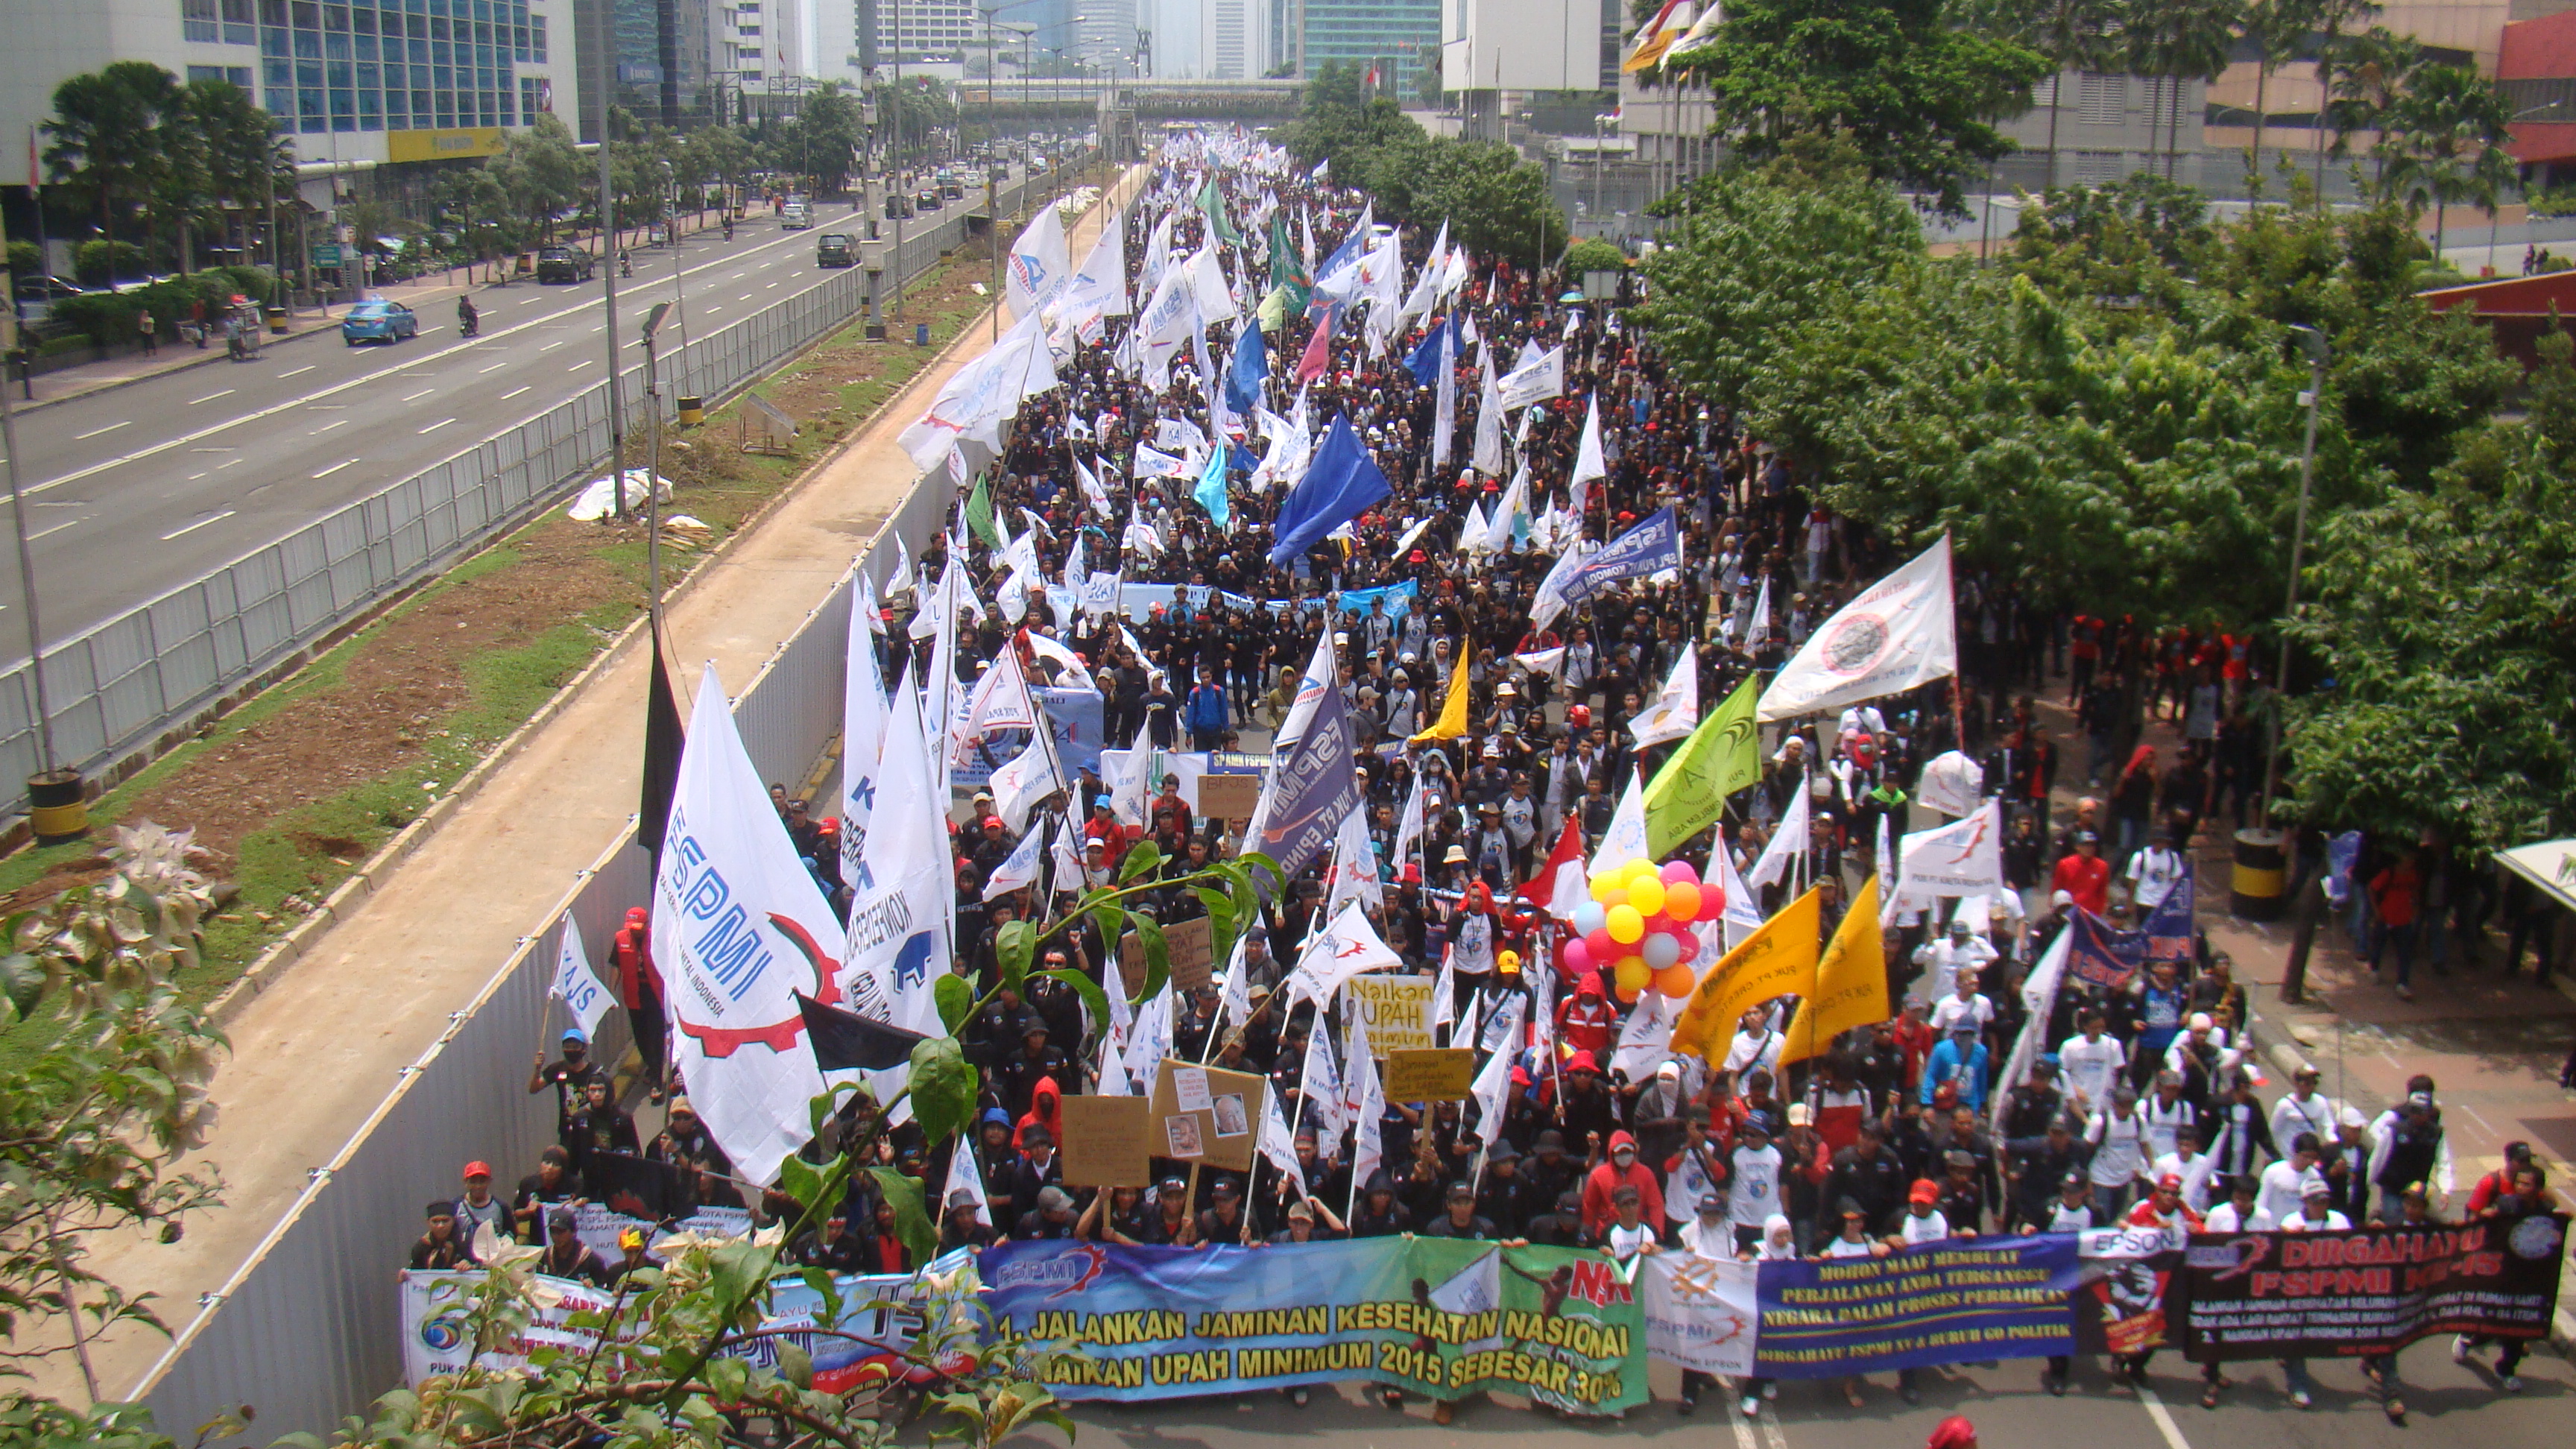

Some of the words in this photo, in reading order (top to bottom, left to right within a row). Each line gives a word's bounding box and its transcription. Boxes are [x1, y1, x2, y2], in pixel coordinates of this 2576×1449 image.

[1213, 754, 1225, 767] SP
[1225, 754, 1246, 767] AMK
[663, 805, 773, 1001] FSPMI
[691, 974, 725, 1019] INDONESIA
[1362, 1003, 1421, 1029] UPAH
[2094, 1232, 2176, 1252] EPSON
[2281, 1226, 2487, 1266] DIRGAHAYU
[997, 1259, 1076, 1286] FSPMI
[2250, 1268, 2393, 1298] FSPMI
[1781, 1280, 1895, 1304] PERJALANAN
[998, 1315, 1023, 1342] 1.
[1030, 1310, 1186, 1345] JALANKAN
[1194, 1304, 1328, 1339] JAMINAN
[1337, 1301, 1500, 1345] KESEHATAN
[1764, 1308, 1835, 1327] NEGARA
[1838, 1300, 1895, 1322] DALAM
[2007, 1323, 2071, 1339] POLITIK
[430, 1363, 455, 1374] PUK
[1152, 1350, 1229, 1385] UPAH
[1238, 1342, 1373, 1379] MINIMUM
[1380, 1340, 1444, 1386] 2015
[1448, 1350, 1570, 1396] SEBESAR
[1574, 1370, 1622, 1404] 30%
